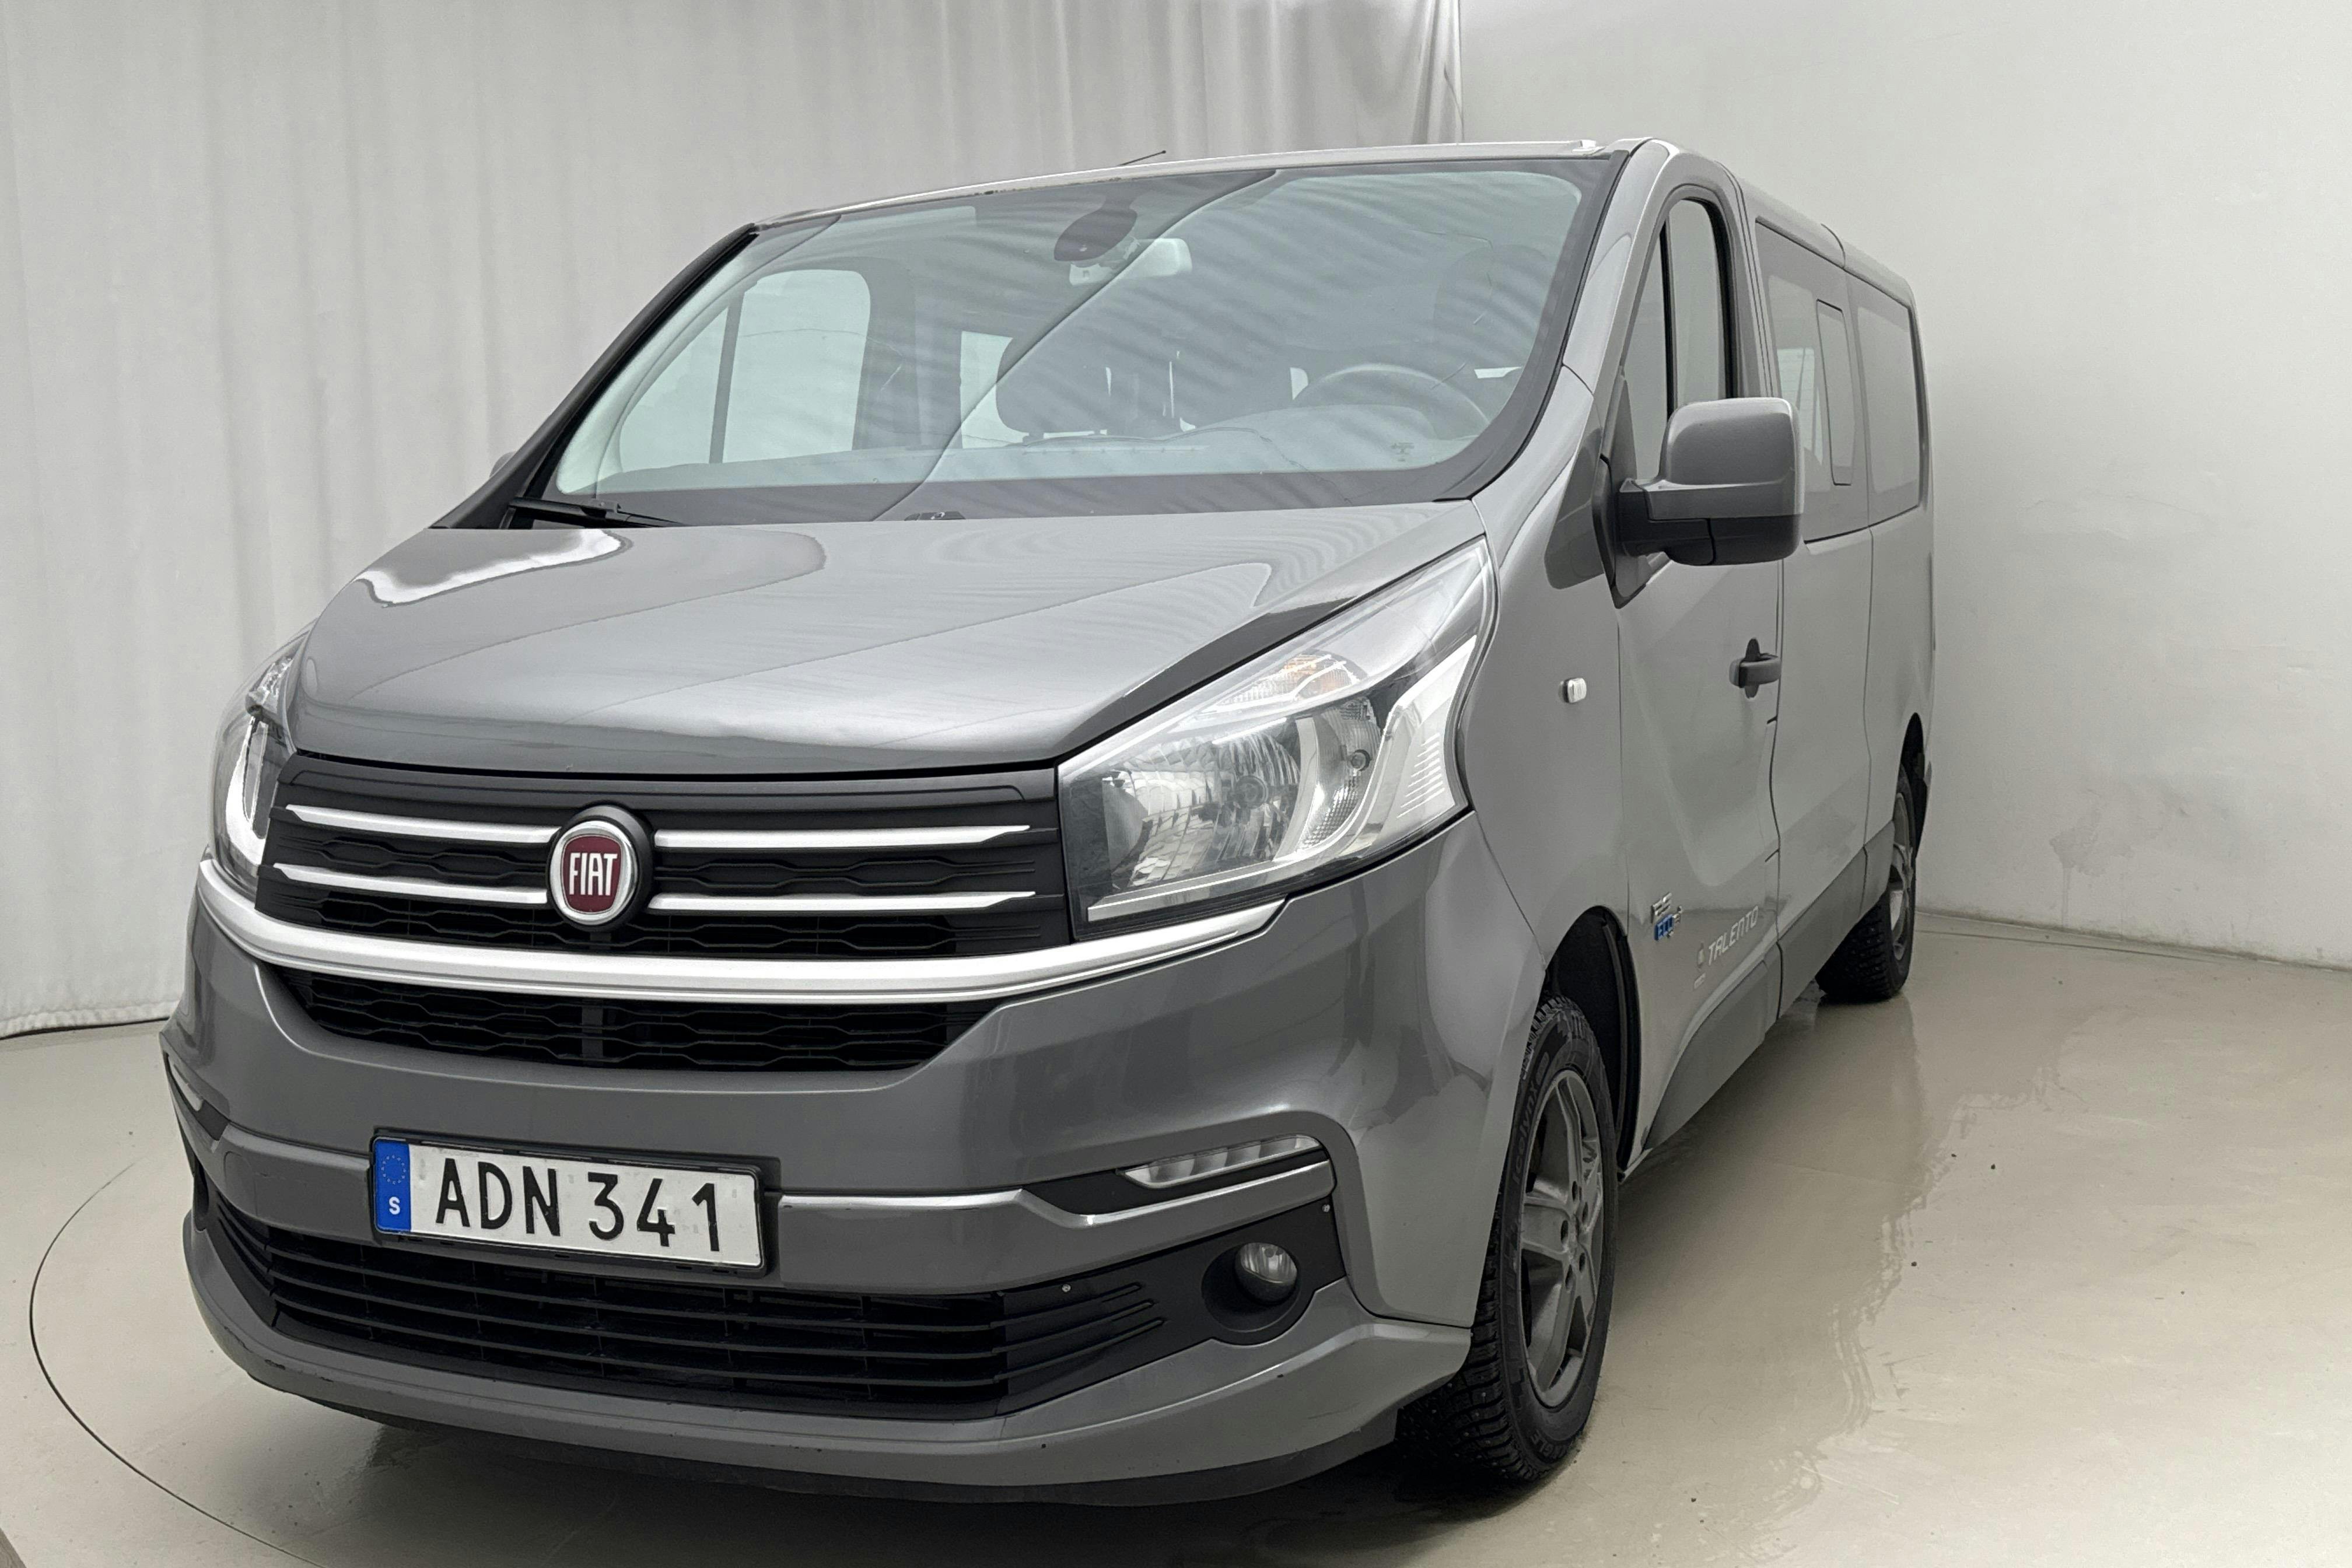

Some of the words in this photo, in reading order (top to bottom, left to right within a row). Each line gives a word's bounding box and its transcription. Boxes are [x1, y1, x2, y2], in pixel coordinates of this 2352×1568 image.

[569, 852, 618, 896] FIAT
[1709, 905, 1759, 965] TALENTO
[388, 1196, 401, 1215] S
[435, 1158, 561, 1237] ADN
[587, 1172, 720, 1252] 341
